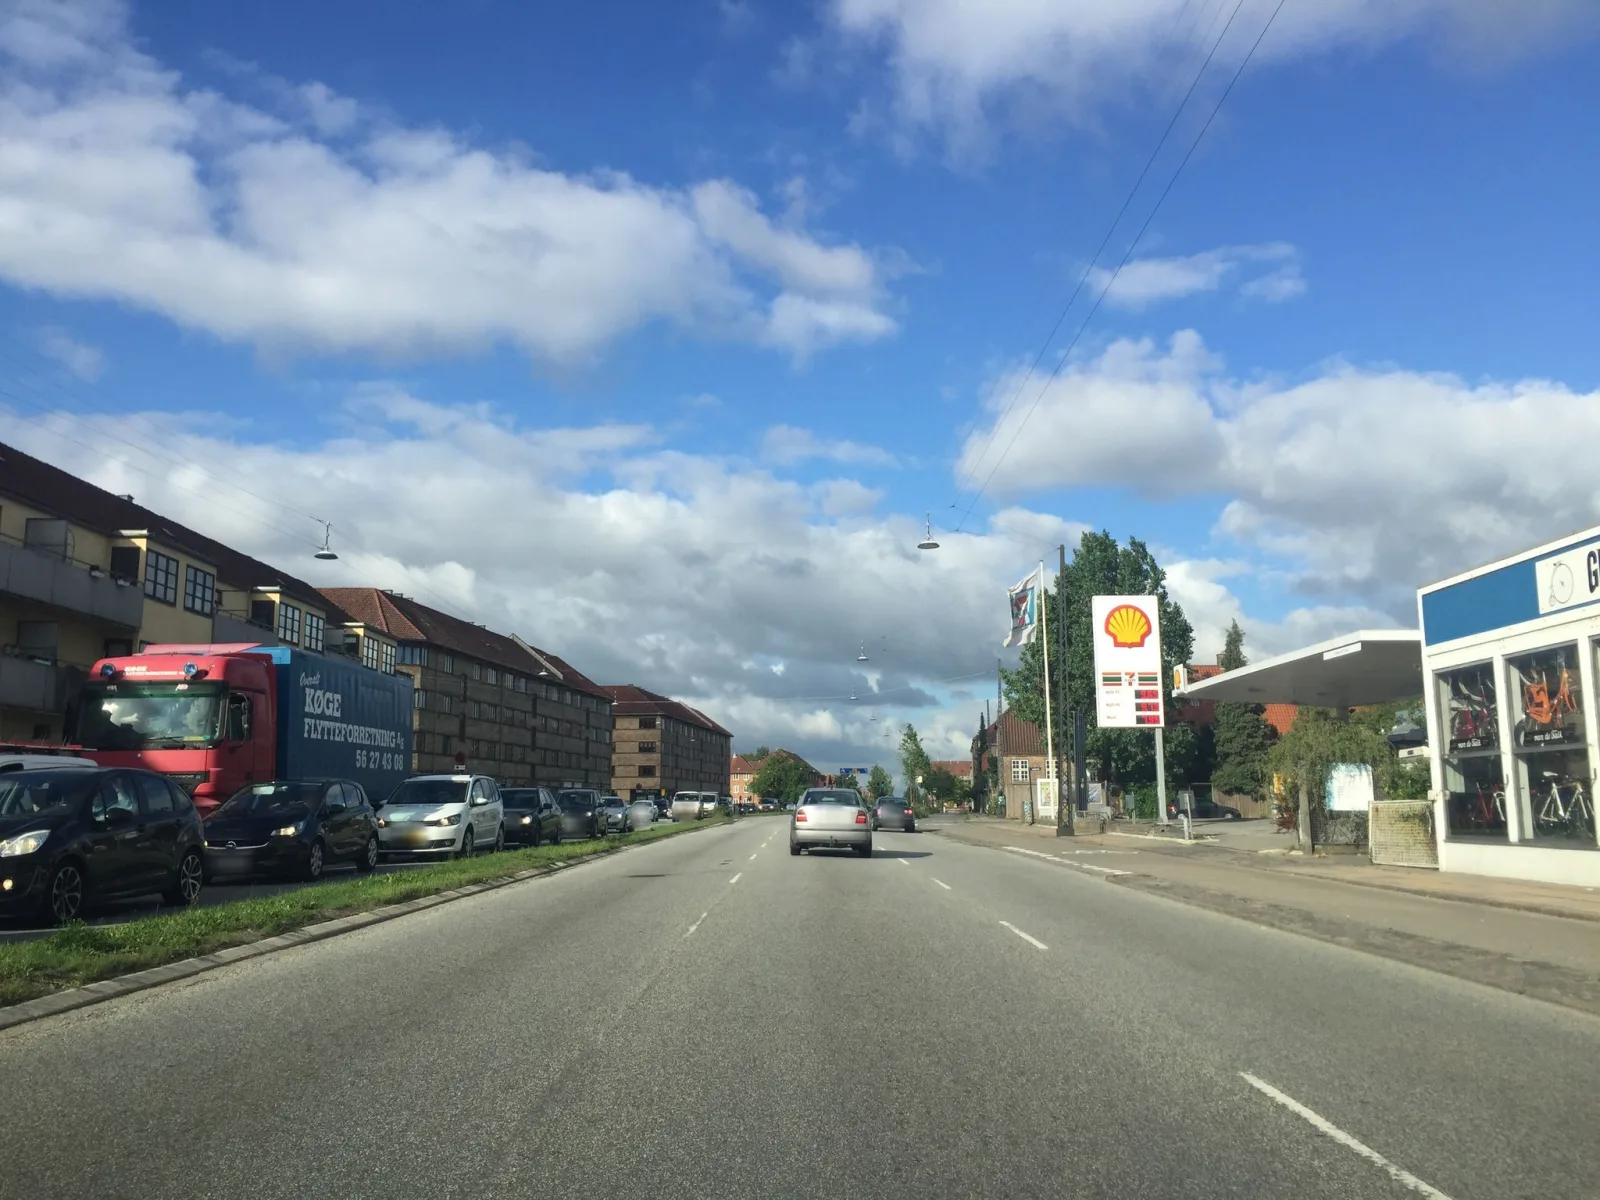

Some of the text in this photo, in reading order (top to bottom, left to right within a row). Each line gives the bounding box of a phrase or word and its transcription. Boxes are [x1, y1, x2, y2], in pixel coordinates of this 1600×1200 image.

[1587, 547, 1600, 593] G
[305, 688, 341, 717] KØGE
[304, 718, 396, 748] FLYTTEFORRETNING
[356, 749, 404, 771] 56 27 43 08
